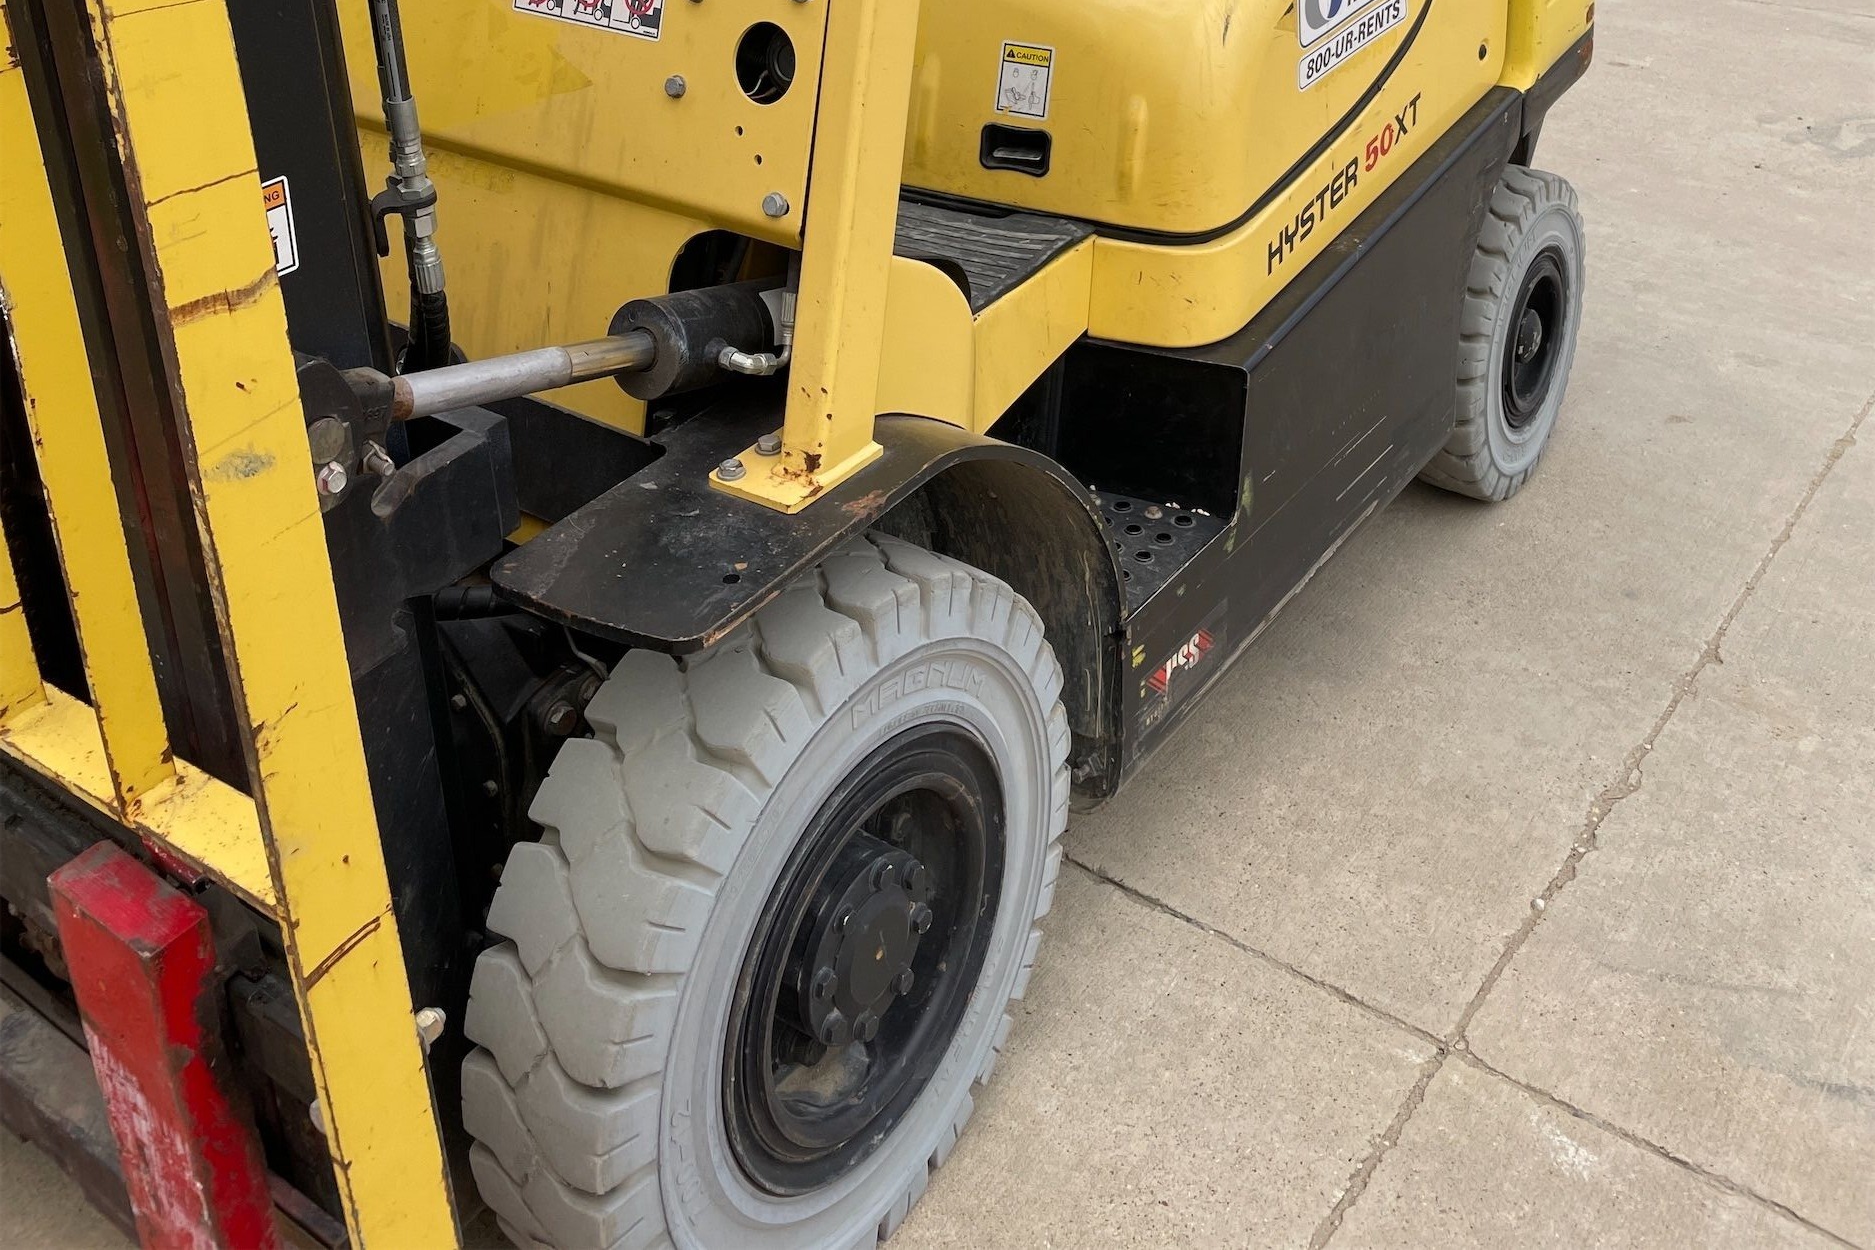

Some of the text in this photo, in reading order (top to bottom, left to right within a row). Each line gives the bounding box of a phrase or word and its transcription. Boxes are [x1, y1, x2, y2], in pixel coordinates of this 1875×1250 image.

[1016, 52, 1049, 62] CAUTION
[1307, 0, 1401, 80] 800-UR-RENTS
[1268, 91, 1421, 277] HYSTER 50XT
[852, 661, 986, 731] MAGNUM
